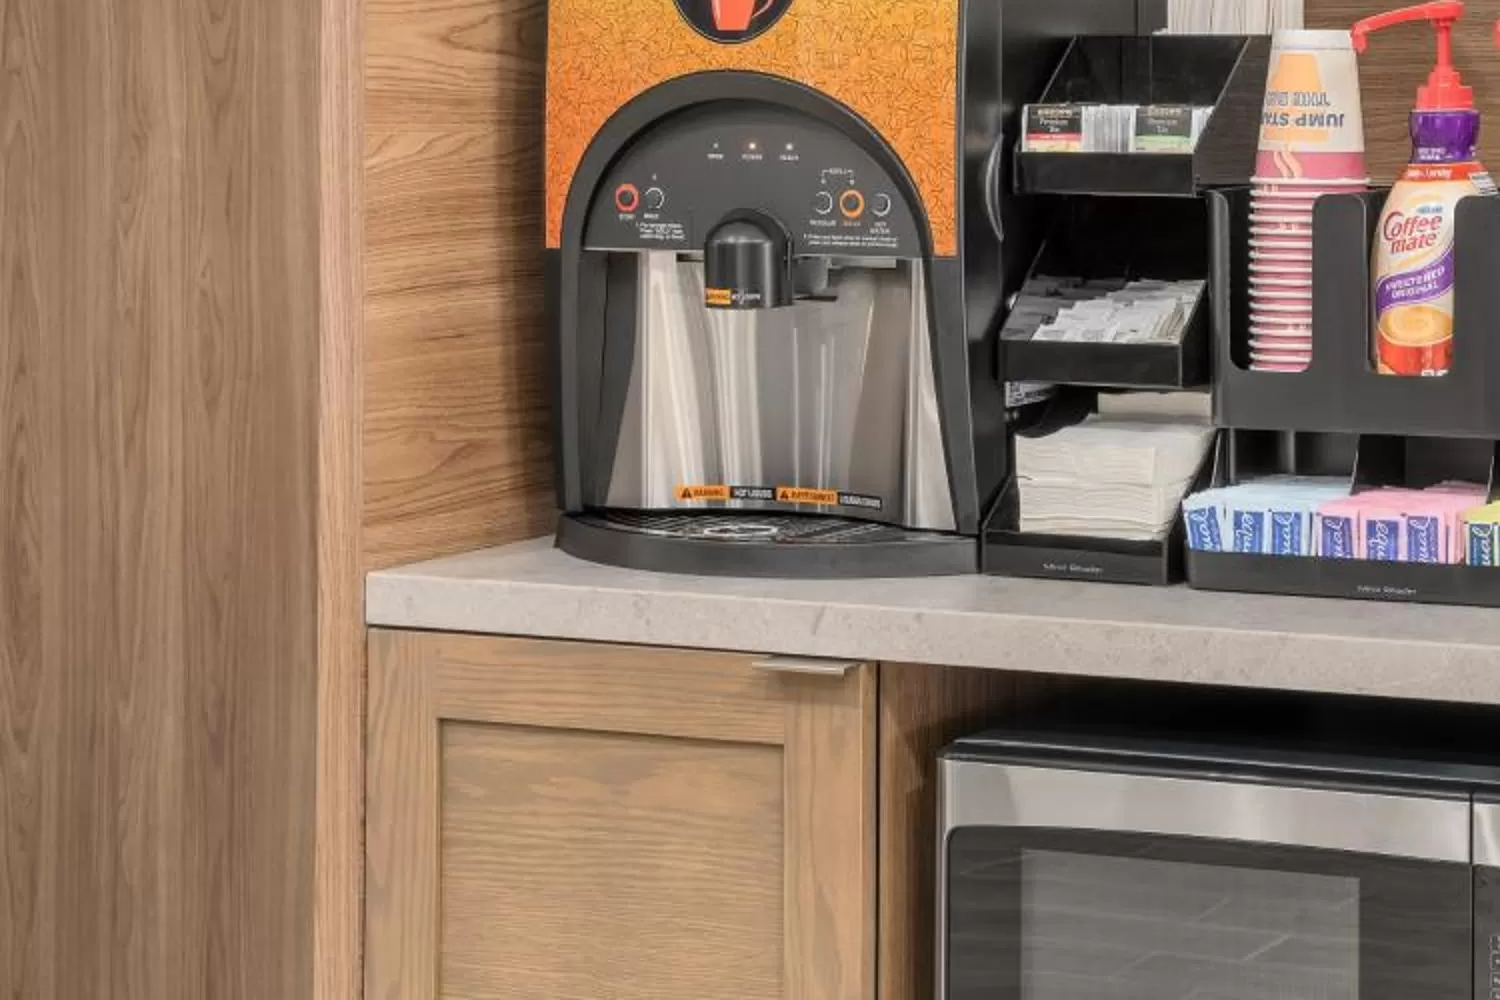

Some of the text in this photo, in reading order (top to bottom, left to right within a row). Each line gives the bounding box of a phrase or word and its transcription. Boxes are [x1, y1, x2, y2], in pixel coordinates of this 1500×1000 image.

[1295, 113, 1345, 128] JUMP
[1383, 210, 1443, 241] Coffee
[1390, 232, 1438, 255] mate
